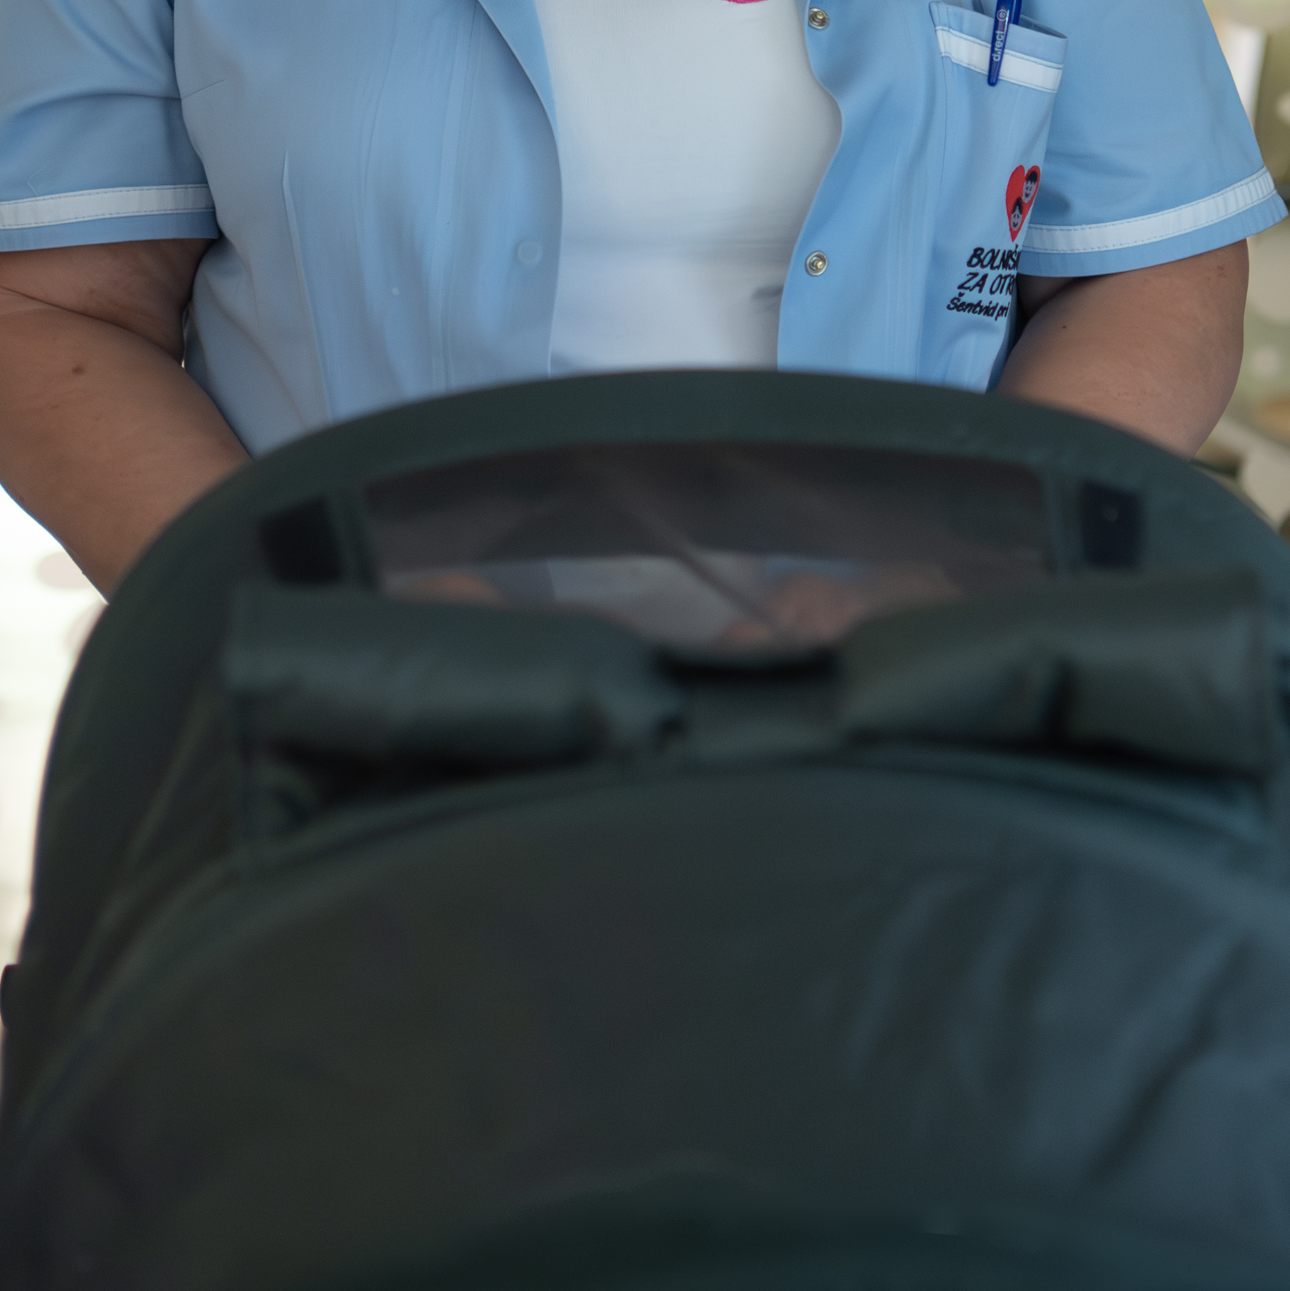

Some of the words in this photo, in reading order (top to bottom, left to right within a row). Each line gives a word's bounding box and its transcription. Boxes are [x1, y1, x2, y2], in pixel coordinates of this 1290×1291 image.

[957, 272, 988, 294] ZA
[946, 291, 999, 317] Šentvid
[994, 302, 1011, 321] pri
